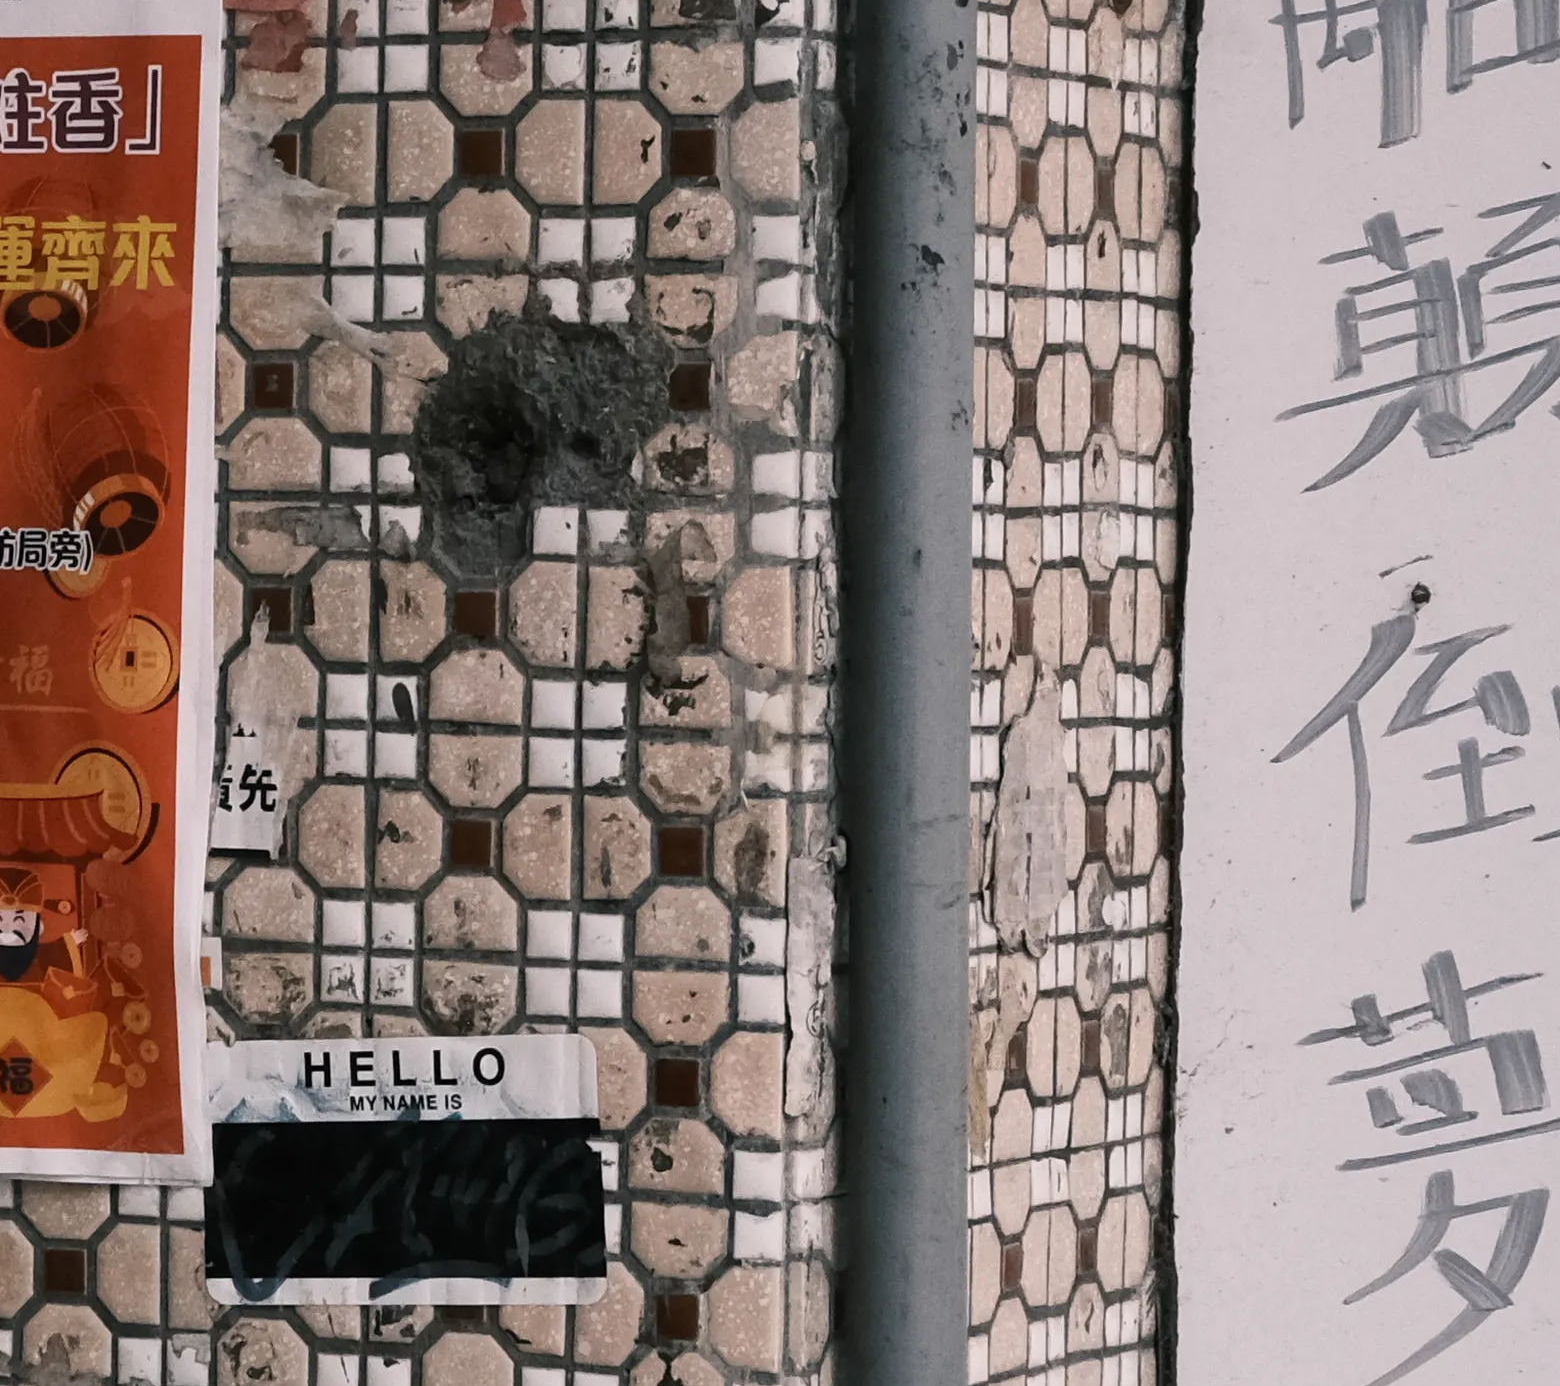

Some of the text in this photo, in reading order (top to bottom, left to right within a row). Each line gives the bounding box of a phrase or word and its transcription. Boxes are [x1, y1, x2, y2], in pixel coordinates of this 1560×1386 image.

[303, 1047, 506, 1089] HELLO
[350, 1093, 463, 1112] MY NAME IS
